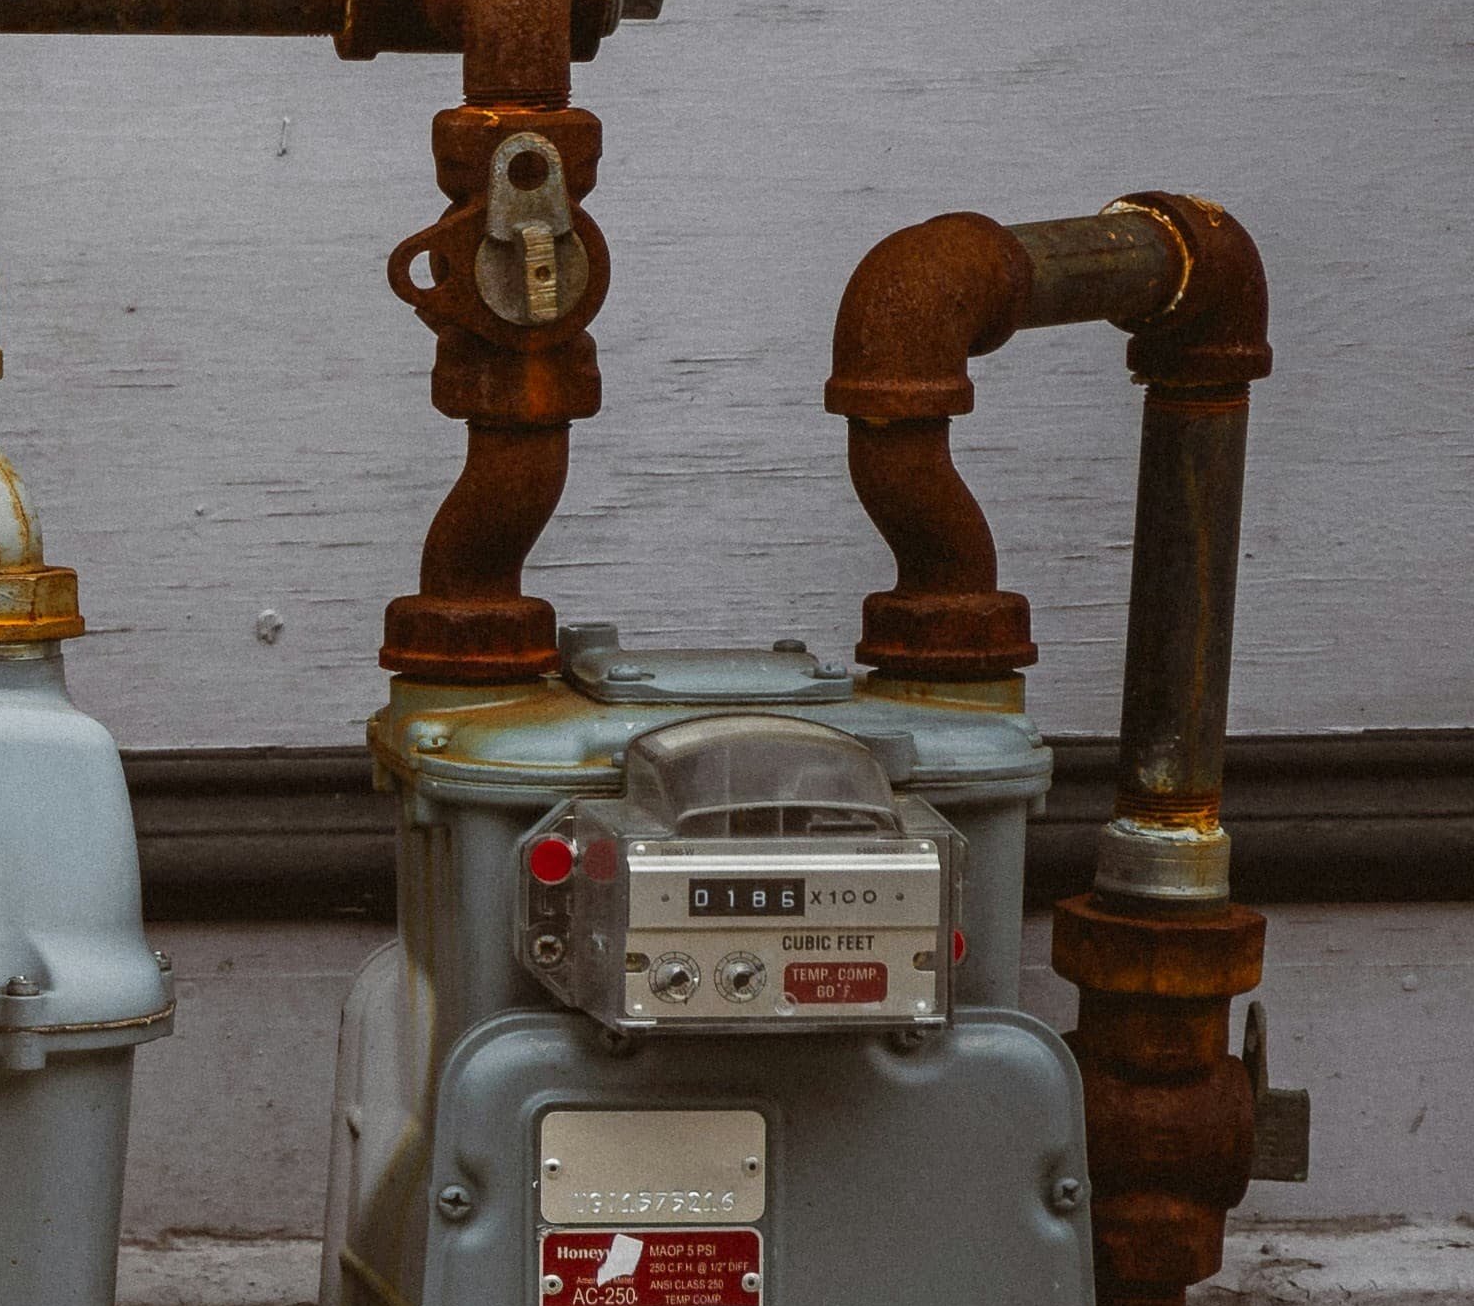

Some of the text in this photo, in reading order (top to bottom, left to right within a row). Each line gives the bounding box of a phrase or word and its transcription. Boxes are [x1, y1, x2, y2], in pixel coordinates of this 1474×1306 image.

[693, 888, 796, 909] 0186
[781, 934, 875, 951] CUBIC FEET
[557, 1244, 716, 1262] Honey MAOP 5 PSI
[649, 1263, 666, 1273] 250
[697, 1262, 707, 1274] @
[649, 1279, 724, 1290] ANSI CLASS 250
[572, 1287, 636, 1306] AC-250
